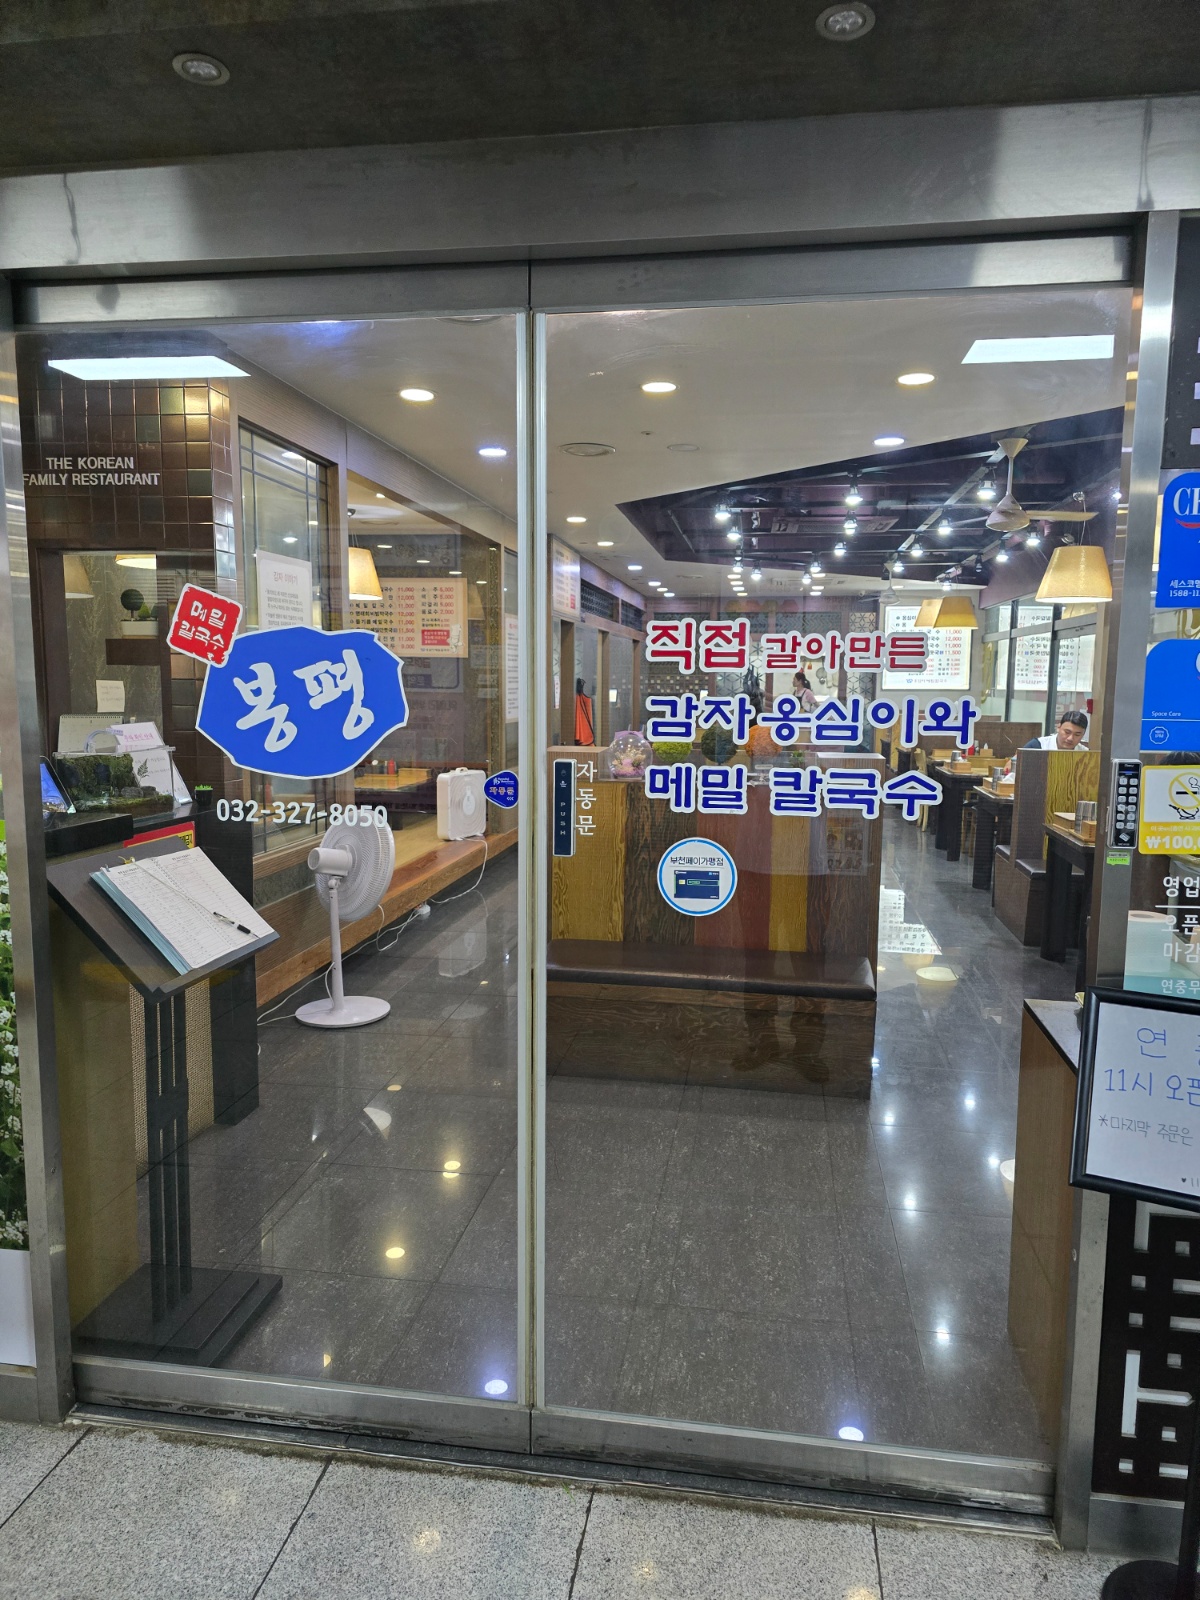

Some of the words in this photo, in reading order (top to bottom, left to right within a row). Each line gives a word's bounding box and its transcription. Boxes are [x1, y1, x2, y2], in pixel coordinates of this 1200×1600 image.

[46, 457, 73, 469] THE
[78, 457, 134, 469] KOREAN
[23, 473, 68, 486] FAMILY
[72, 473, 160, 486] RESTAURANT
[190, 600, 227, 630] 메밀
[178, 620, 225, 651] 칼국수
[649, 621, 748, 671] 직접
[232, 649, 375, 752] 봉평
[576, 760, 598, 836] 자동문
[649, 766, 745, 811] 메밀
[772, 768, 939, 817] 칼국수
[216, 799, 388, 828] 032-327-8050
[670, 856, 724, 866] 부천페이가맹점
[1163, 876, 1200, 897] 영업
[1161, 915, 1199, 935] 오픈
[1163, 942, 1200, 963] 마감
[1104, 1068, 1152, 1096] 11시
[1157, 1124, 1193, 1147] 주문은
